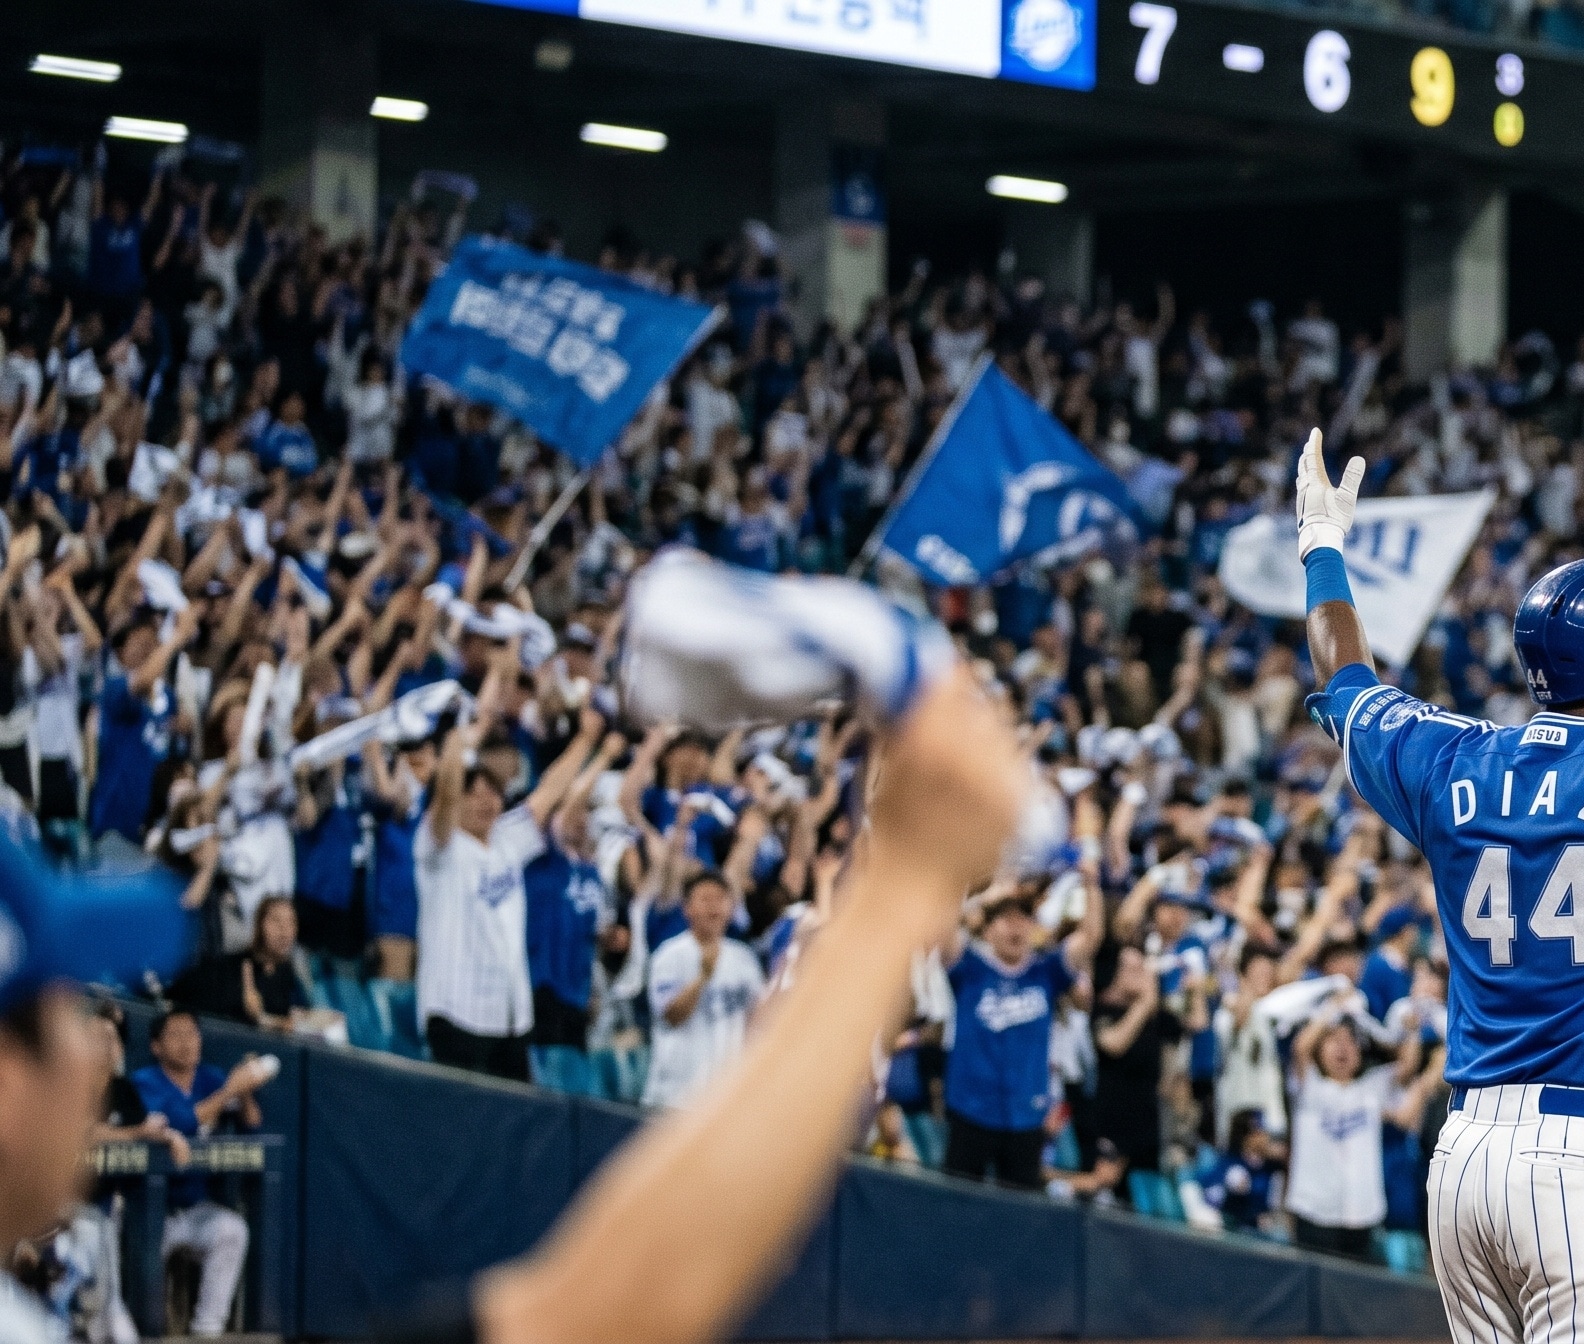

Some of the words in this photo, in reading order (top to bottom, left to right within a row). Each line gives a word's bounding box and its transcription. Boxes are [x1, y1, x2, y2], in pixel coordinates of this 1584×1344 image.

[1129, 1, 1177, 85] 7
[1223, 43, 1264, 73] -
[1303, 30, 1351, 113] 6
[1410, 47, 1455, 127] 9
[1527, 668, 1548, 689] 44
